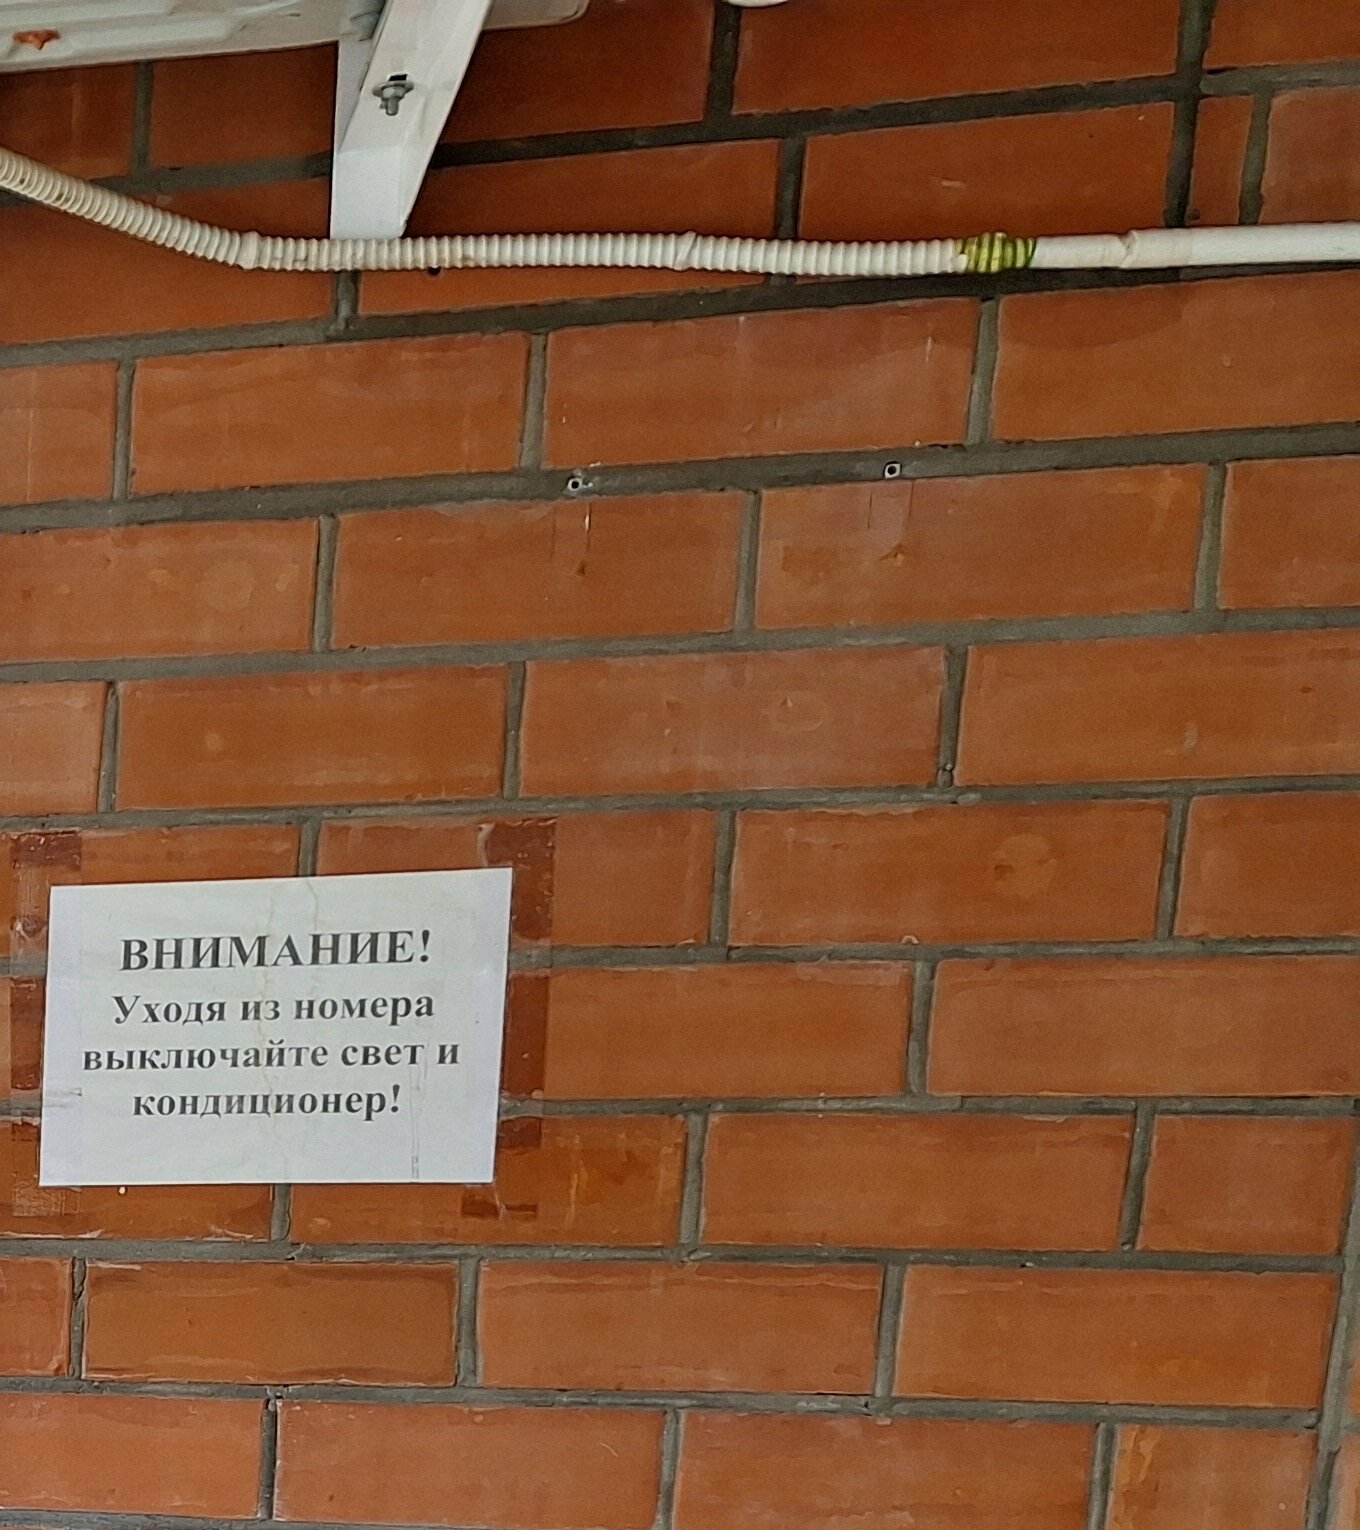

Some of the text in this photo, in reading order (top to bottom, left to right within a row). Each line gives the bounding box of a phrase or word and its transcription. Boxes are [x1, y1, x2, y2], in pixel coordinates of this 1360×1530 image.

[120, 929, 431, 972] ВНИМАНИЕ!
[112, 993, 435, 1027] Уходя из номера
[83, 1038, 461, 1072] выключайте свет и
[132, 1084, 401, 1122] кондиционер!
